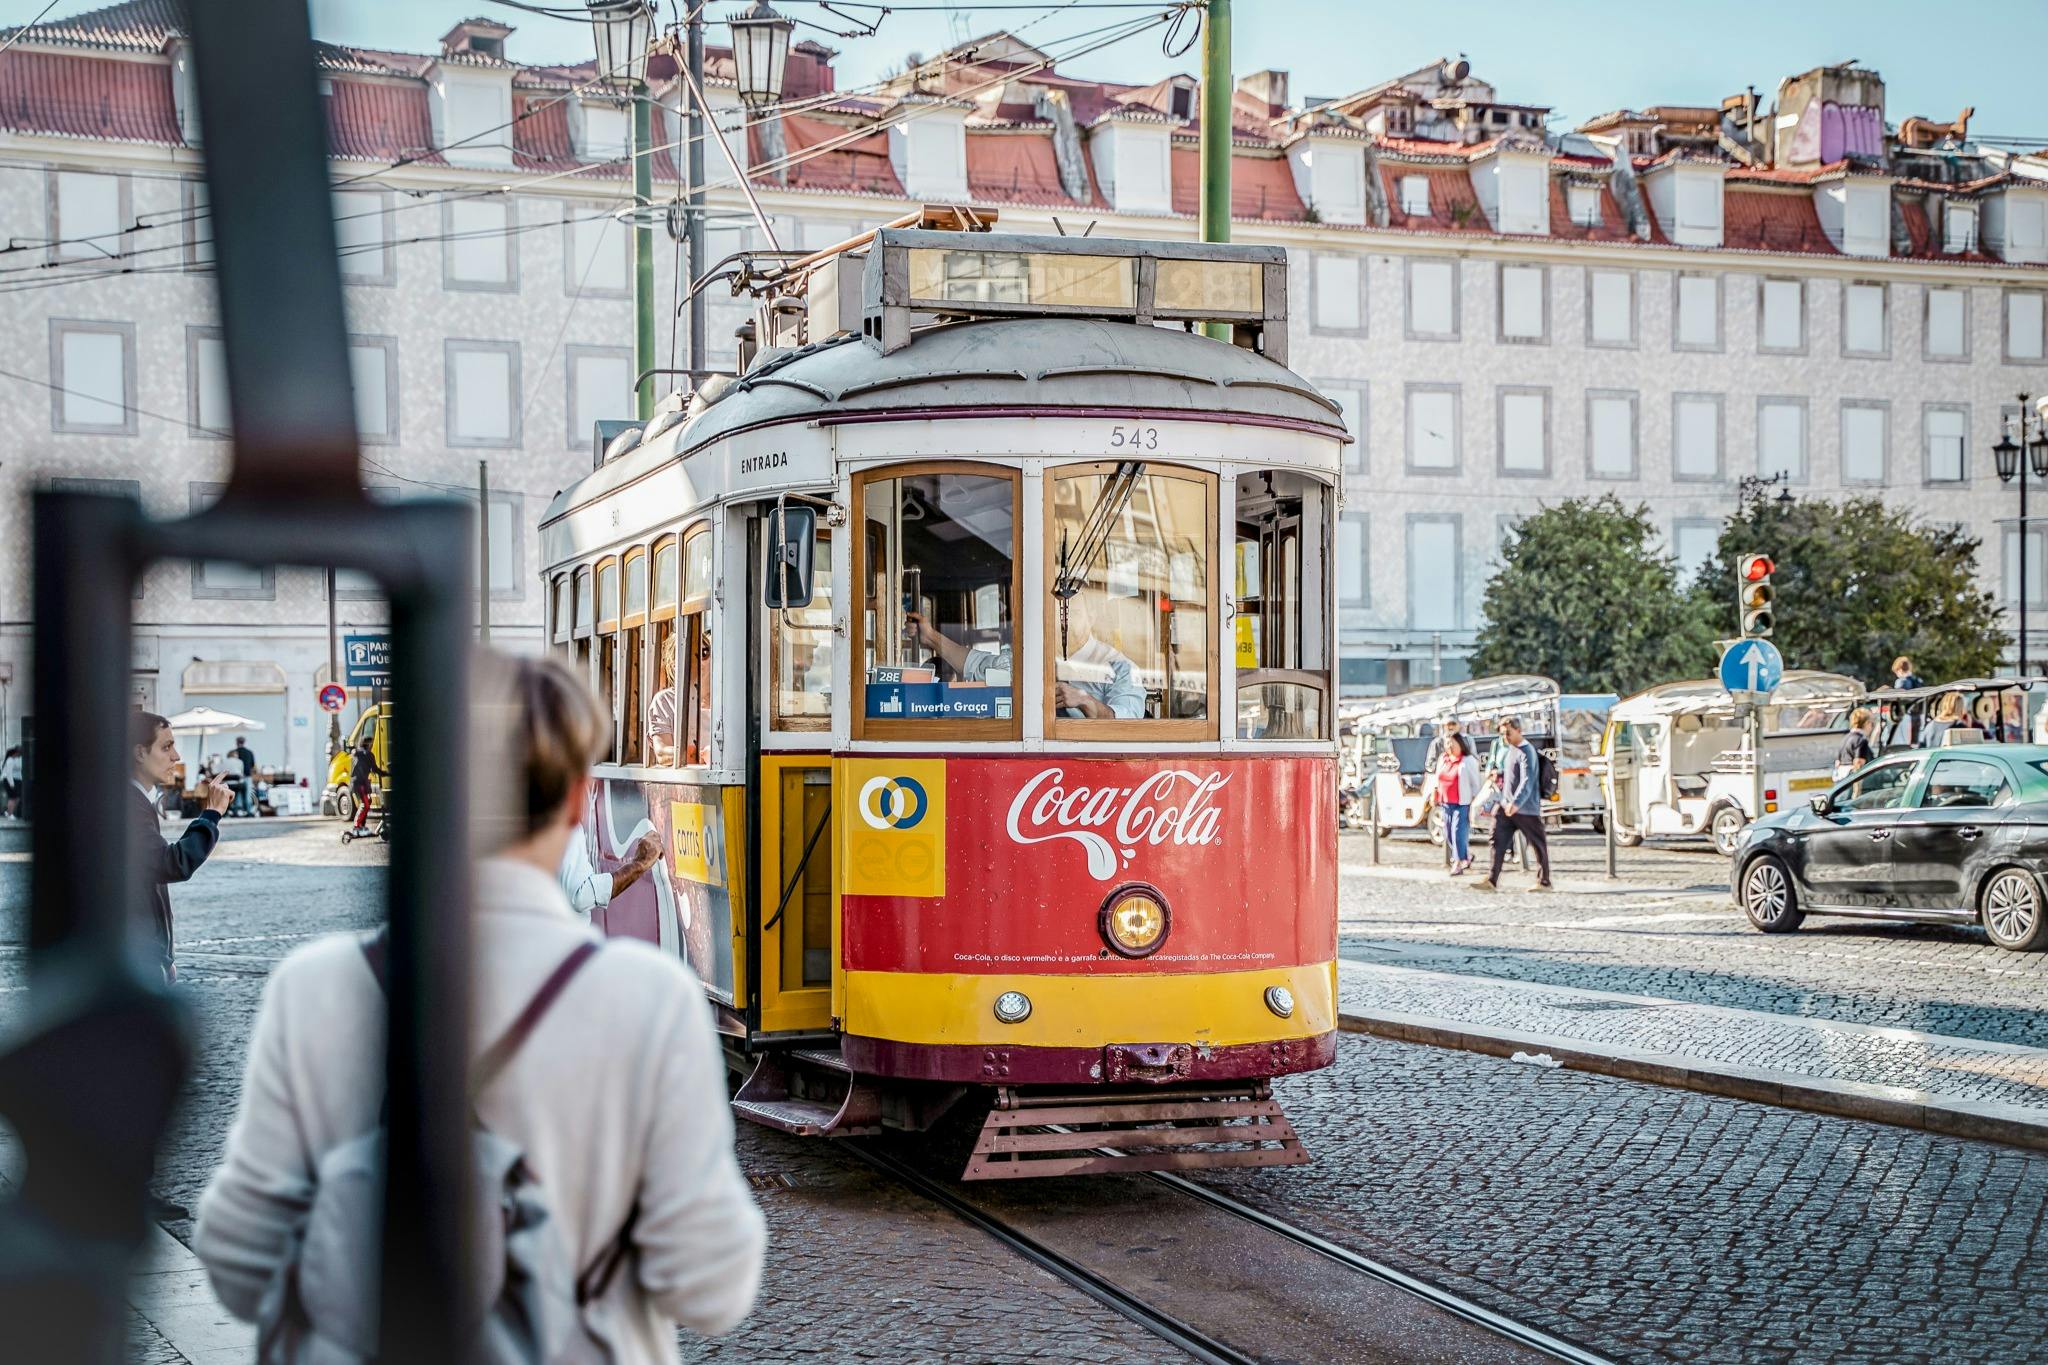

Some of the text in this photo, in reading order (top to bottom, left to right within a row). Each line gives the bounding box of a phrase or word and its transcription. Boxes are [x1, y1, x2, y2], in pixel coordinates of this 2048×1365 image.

[1111, 426, 1158, 449] 543
[741, 451, 788, 474] ENTRADA
[371, 677, 381, 686] 10
[879, 671, 900, 682] 28E
[911, 702, 951, 712] Inverte
[953, 702, 988, 715] Graça
[1006, 767, 1234, 846] Coca-Cola
[953, 953, 993, 962] Coca-Cola,
[1000, 954, 1021, 962] disco
[1022, 954, 1057, 962] vermelho
[1071, 954, 1097, 963] garrafa
[1200, 953, 1209, 961] da
[1210, 953, 1222, 961] The
